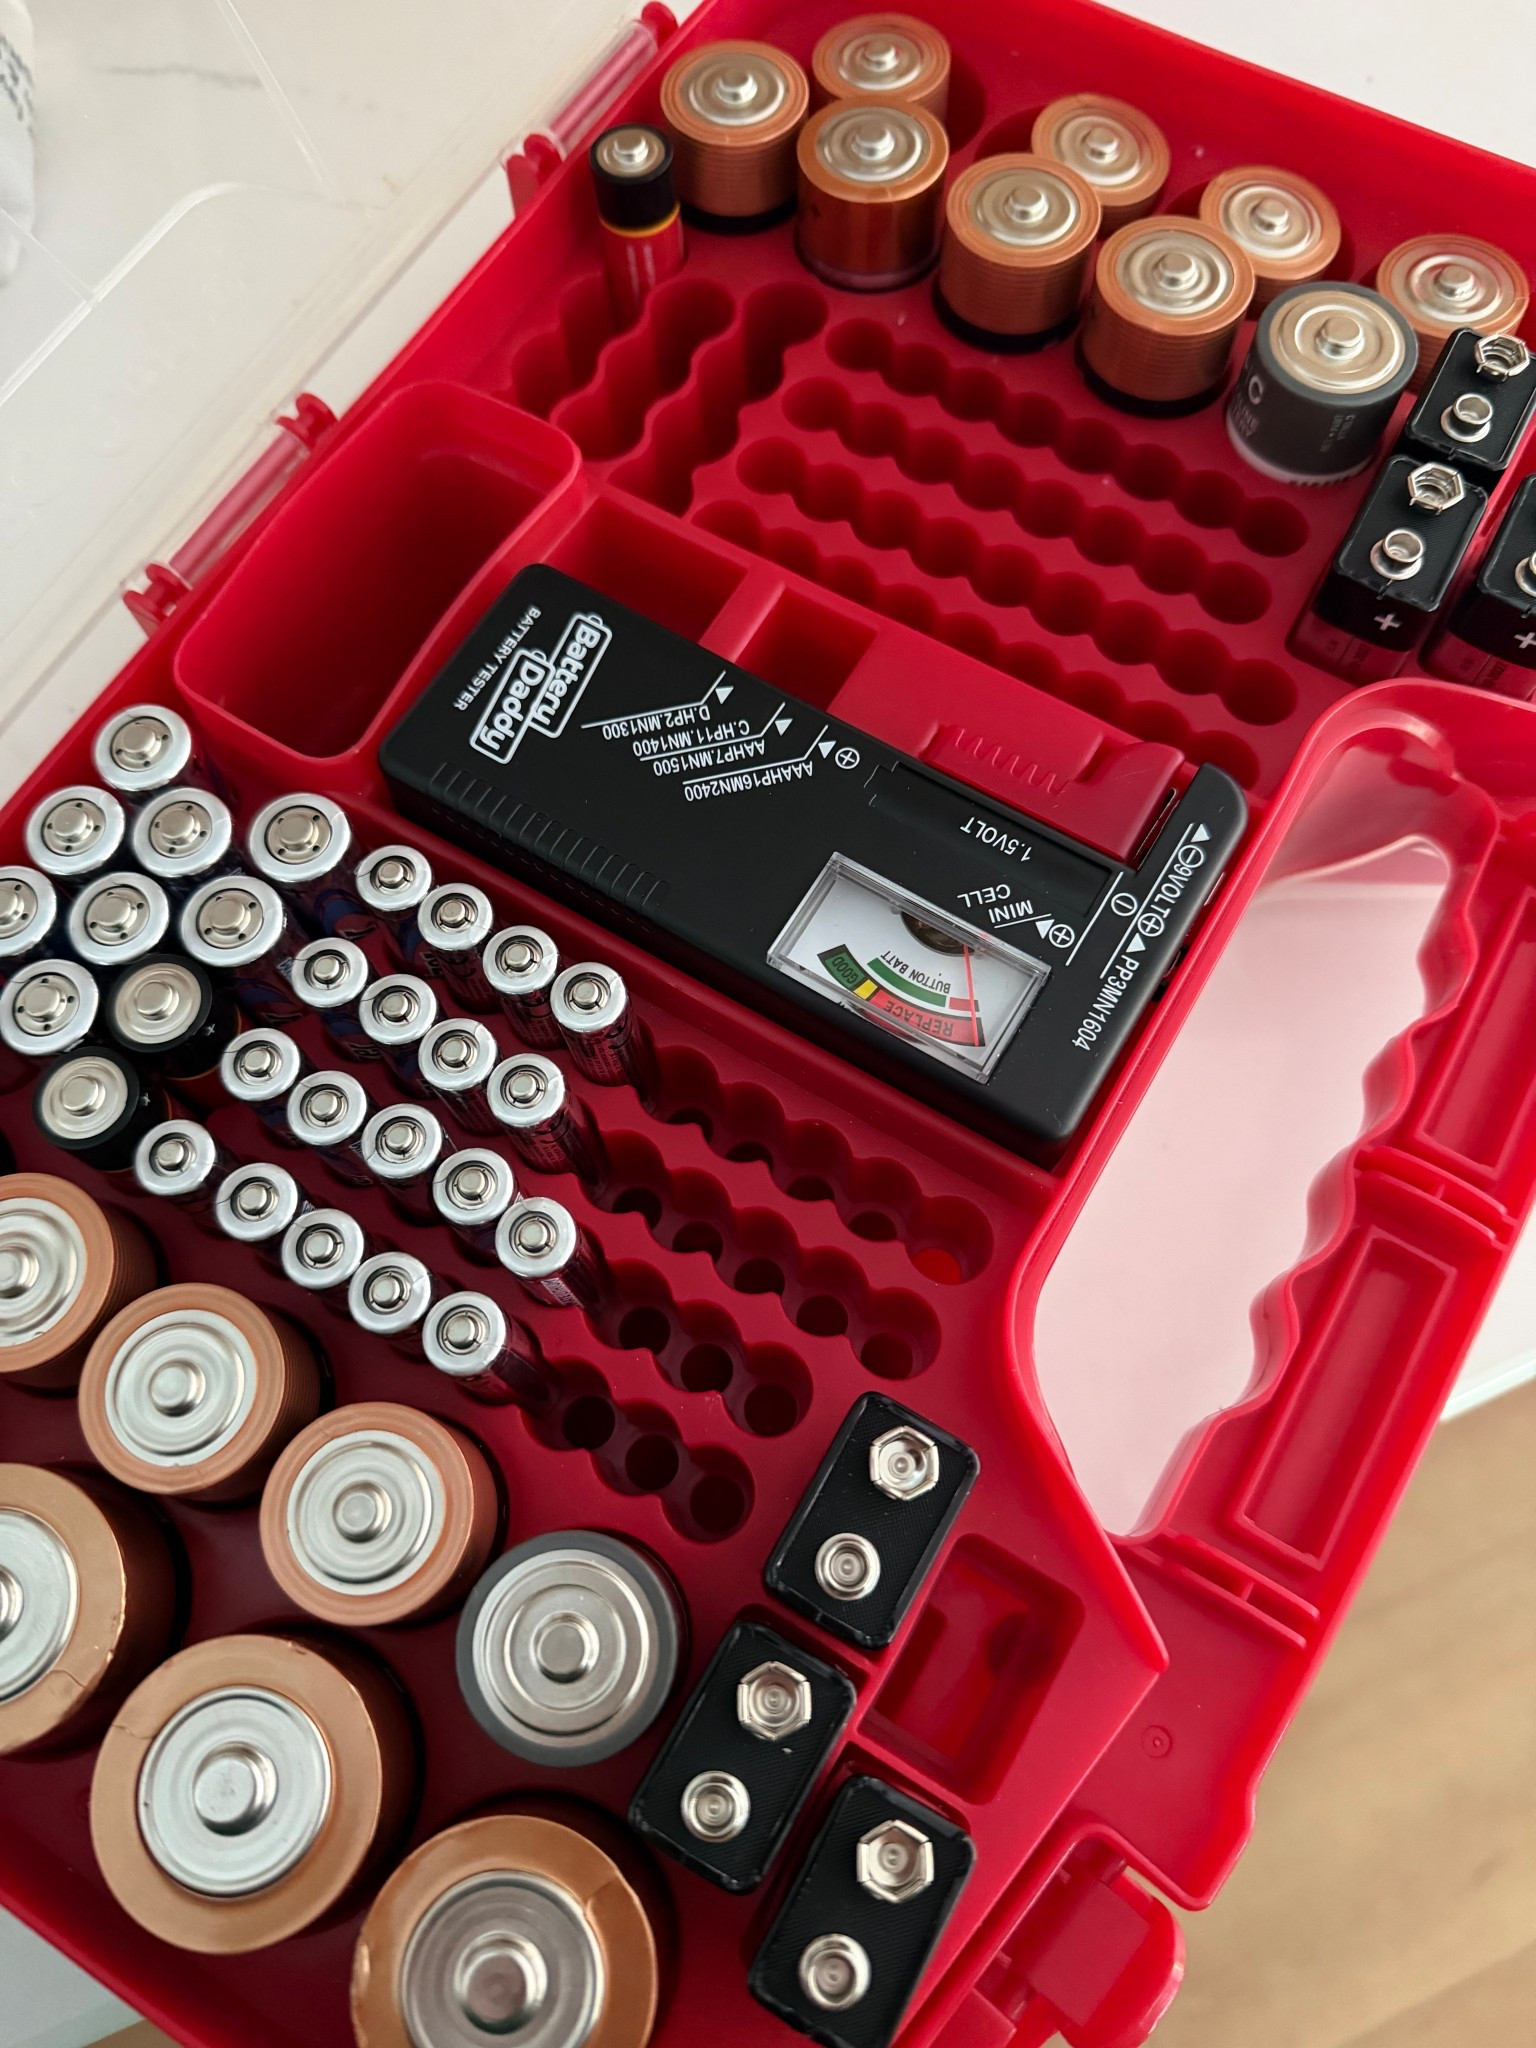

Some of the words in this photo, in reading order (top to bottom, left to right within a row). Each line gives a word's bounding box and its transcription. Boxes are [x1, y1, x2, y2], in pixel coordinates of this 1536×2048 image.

[492, 604, 541, 663] BATTERY
[453, 662, 497, 712] TESTER
[534, 621, 601, 726] Battery
[480, 660, 546, 752] Daddy
[602, 704, 711, 740] D.HP2.MN1300
[632, 719, 750, 757] C.HP11.MN1400
[652, 738, 765, 776] AAHP7.MN1500
[684, 760, 813, 802] AAAHP16MN2400
[959, 816, 1034, 863] 1.5VOLT
[957, 883, 1011, 908] CELL
[1157, 863, 1192, 919] 9VOLT
[988, 900, 1034, 924] MINI
[831, 954, 858, 985] GOOD
[879, 950, 910, 975] BATT
[909, 968, 951, 995] BUTTON
[883, 1000, 954, 1037] REPLACE
[1072, 956, 1139, 1050] PP3MN1604
